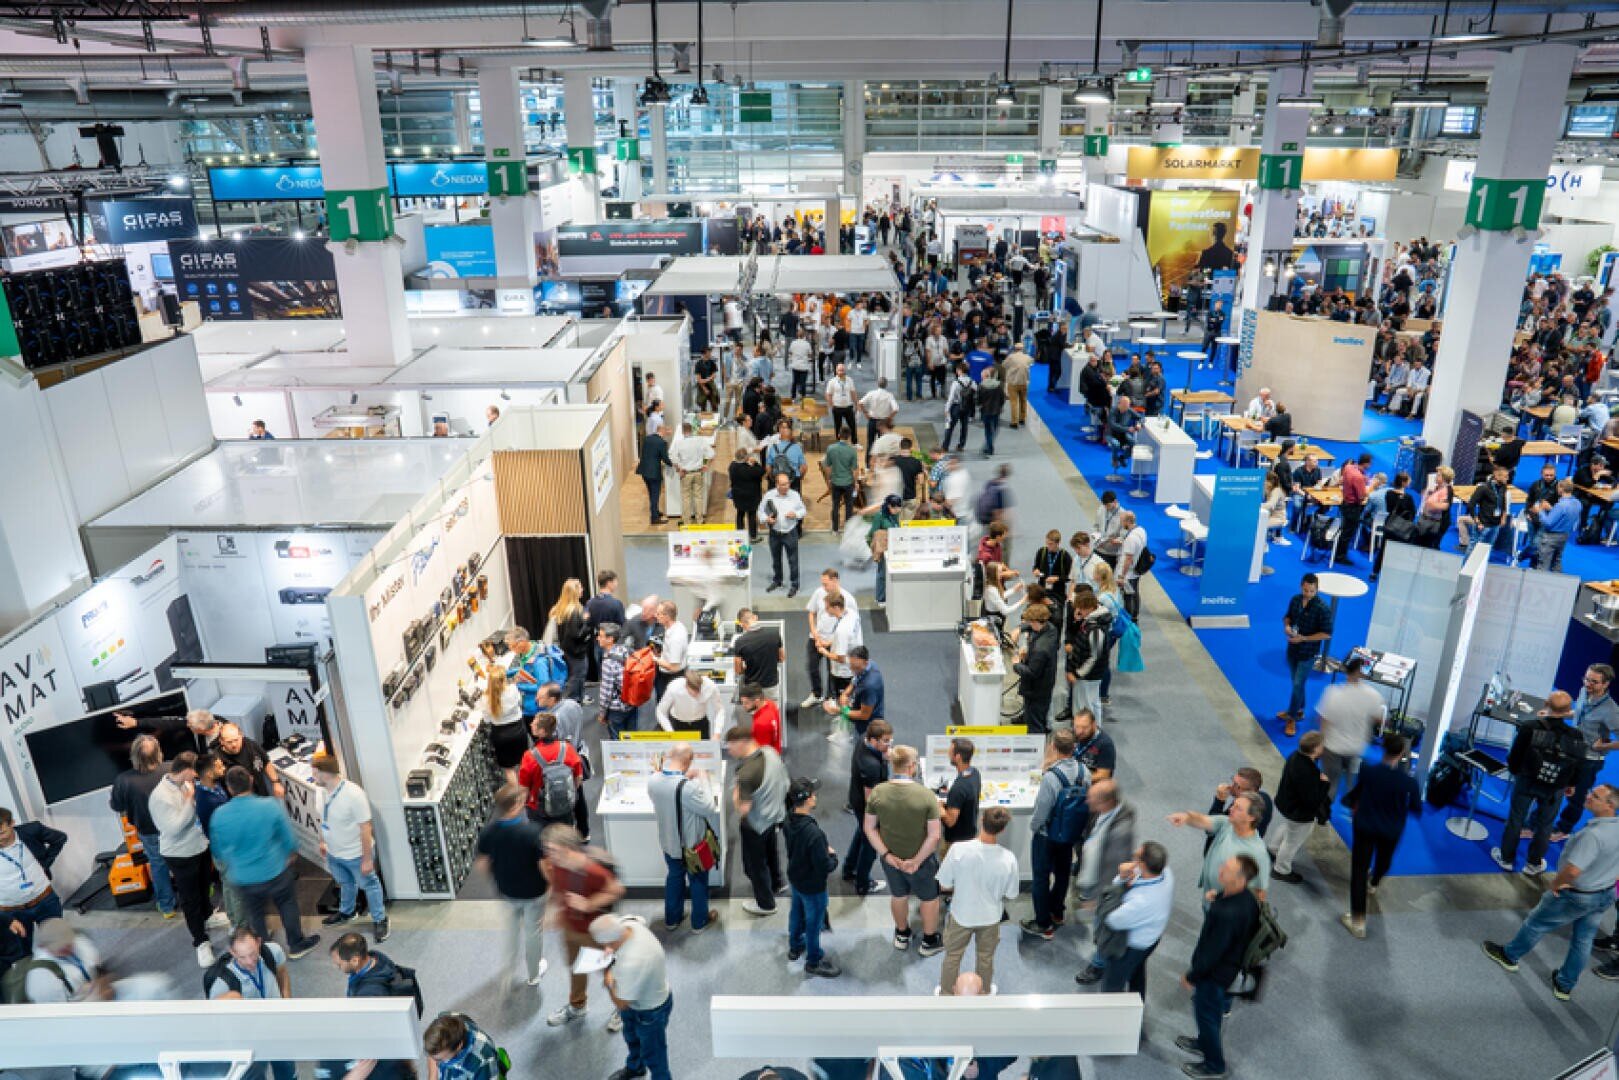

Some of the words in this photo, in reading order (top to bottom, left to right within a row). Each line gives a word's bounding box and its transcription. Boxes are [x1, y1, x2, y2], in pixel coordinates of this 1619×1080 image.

[573, 150, 584, 174] 1
[1164, 159, 1242, 169] SOLARMARKT
[1279, 159, 1292, 185] 1
[294, 179, 323, 189] NIEDA
[494, 165, 509, 192] 1
[337, 195, 359, 235] 1
[377, 193, 389, 232] 1
[1476, 184, 1489, 222] 1
[1508, 184, 1529, 224] 1
[123, 210, 182, 226] GIFAS
[180, 252, 237, 266] GIFAS
[1201, 595, 1237, 605] ineltec
[1, 654, 32, 697] AV
[4, 668, 57, 725] MAT
